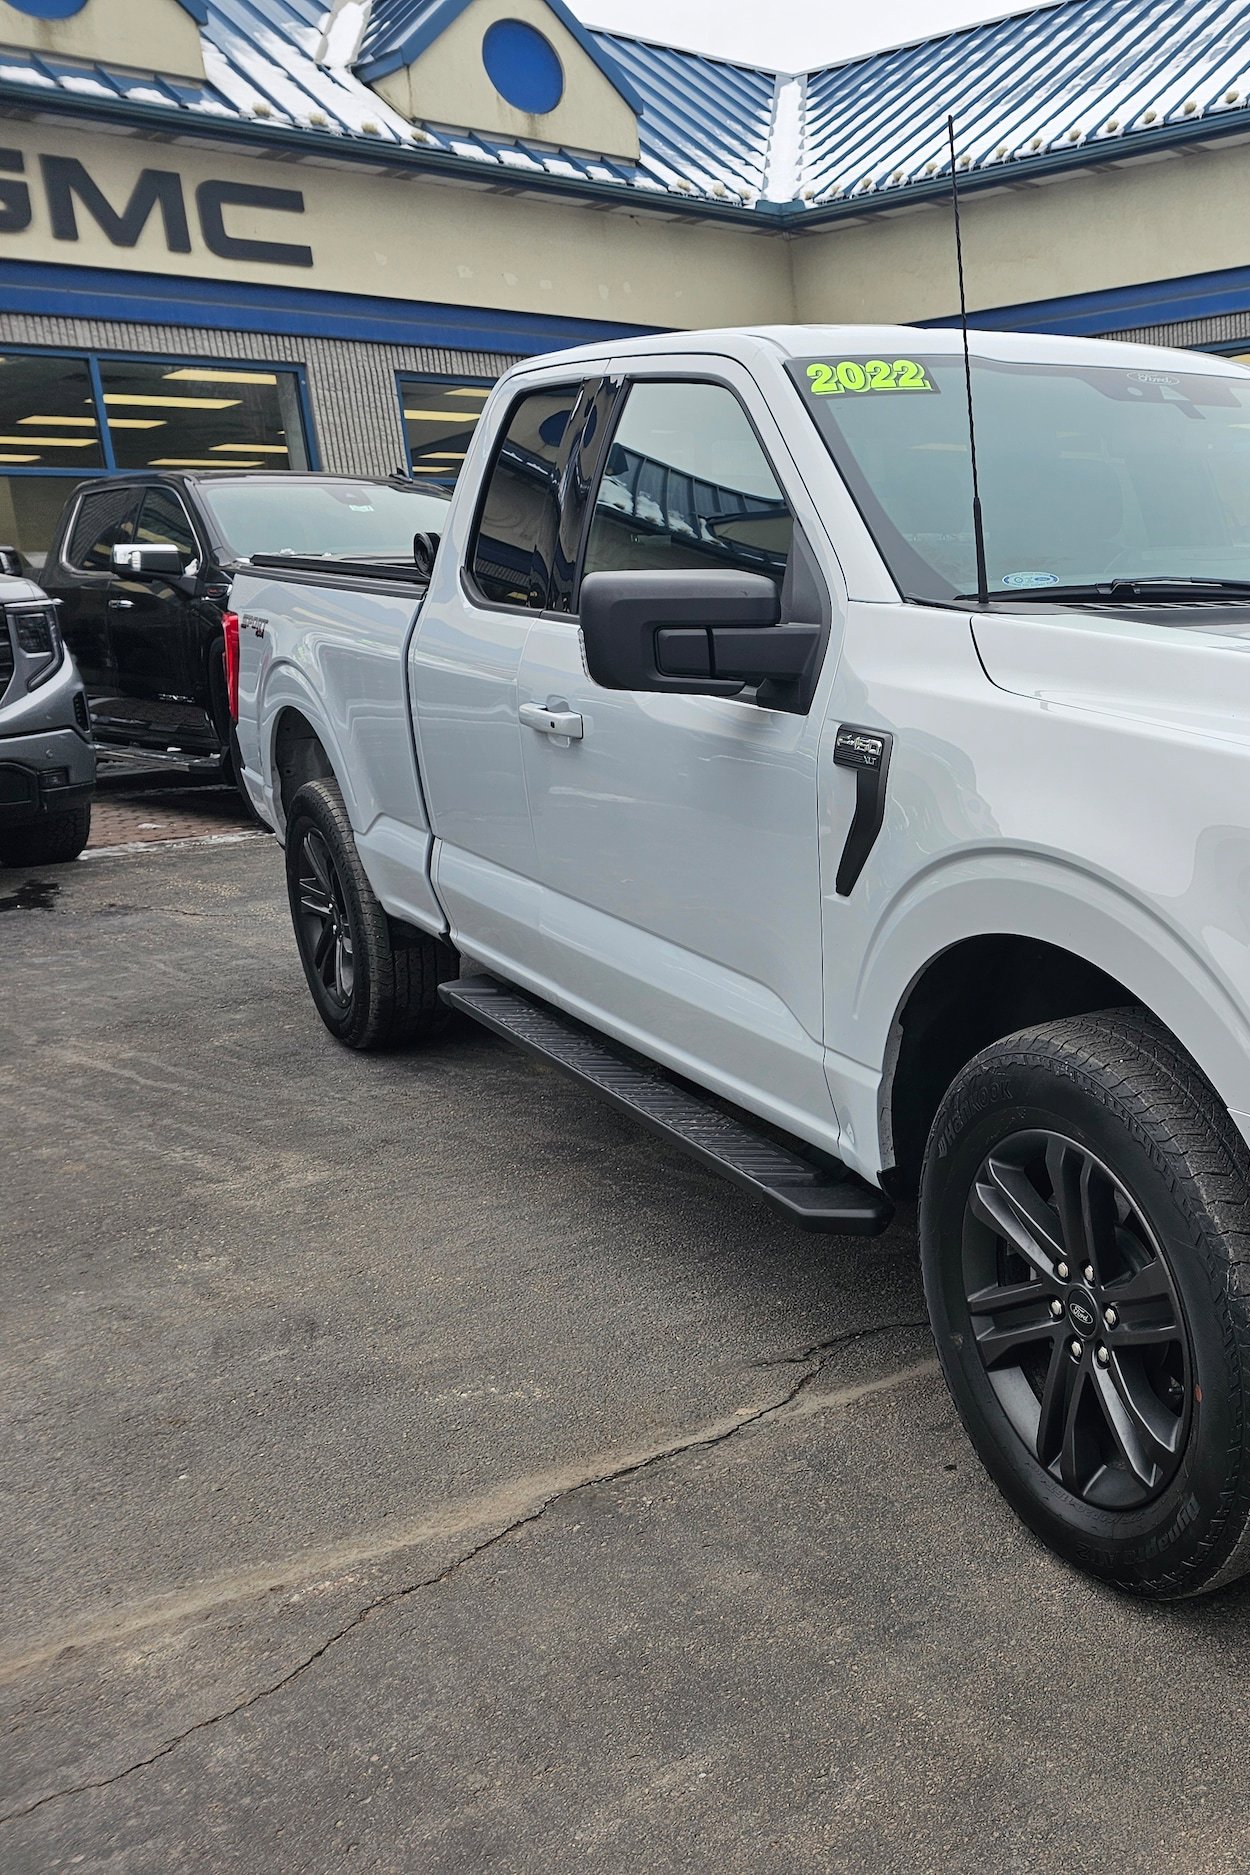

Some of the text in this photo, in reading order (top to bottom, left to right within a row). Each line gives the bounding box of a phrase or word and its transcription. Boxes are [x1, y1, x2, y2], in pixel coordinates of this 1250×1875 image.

[0, 147, 314, 268] MC
[806, 359, 933, 396] 2022
[1073, 1304, 1090, 1322] Ford
